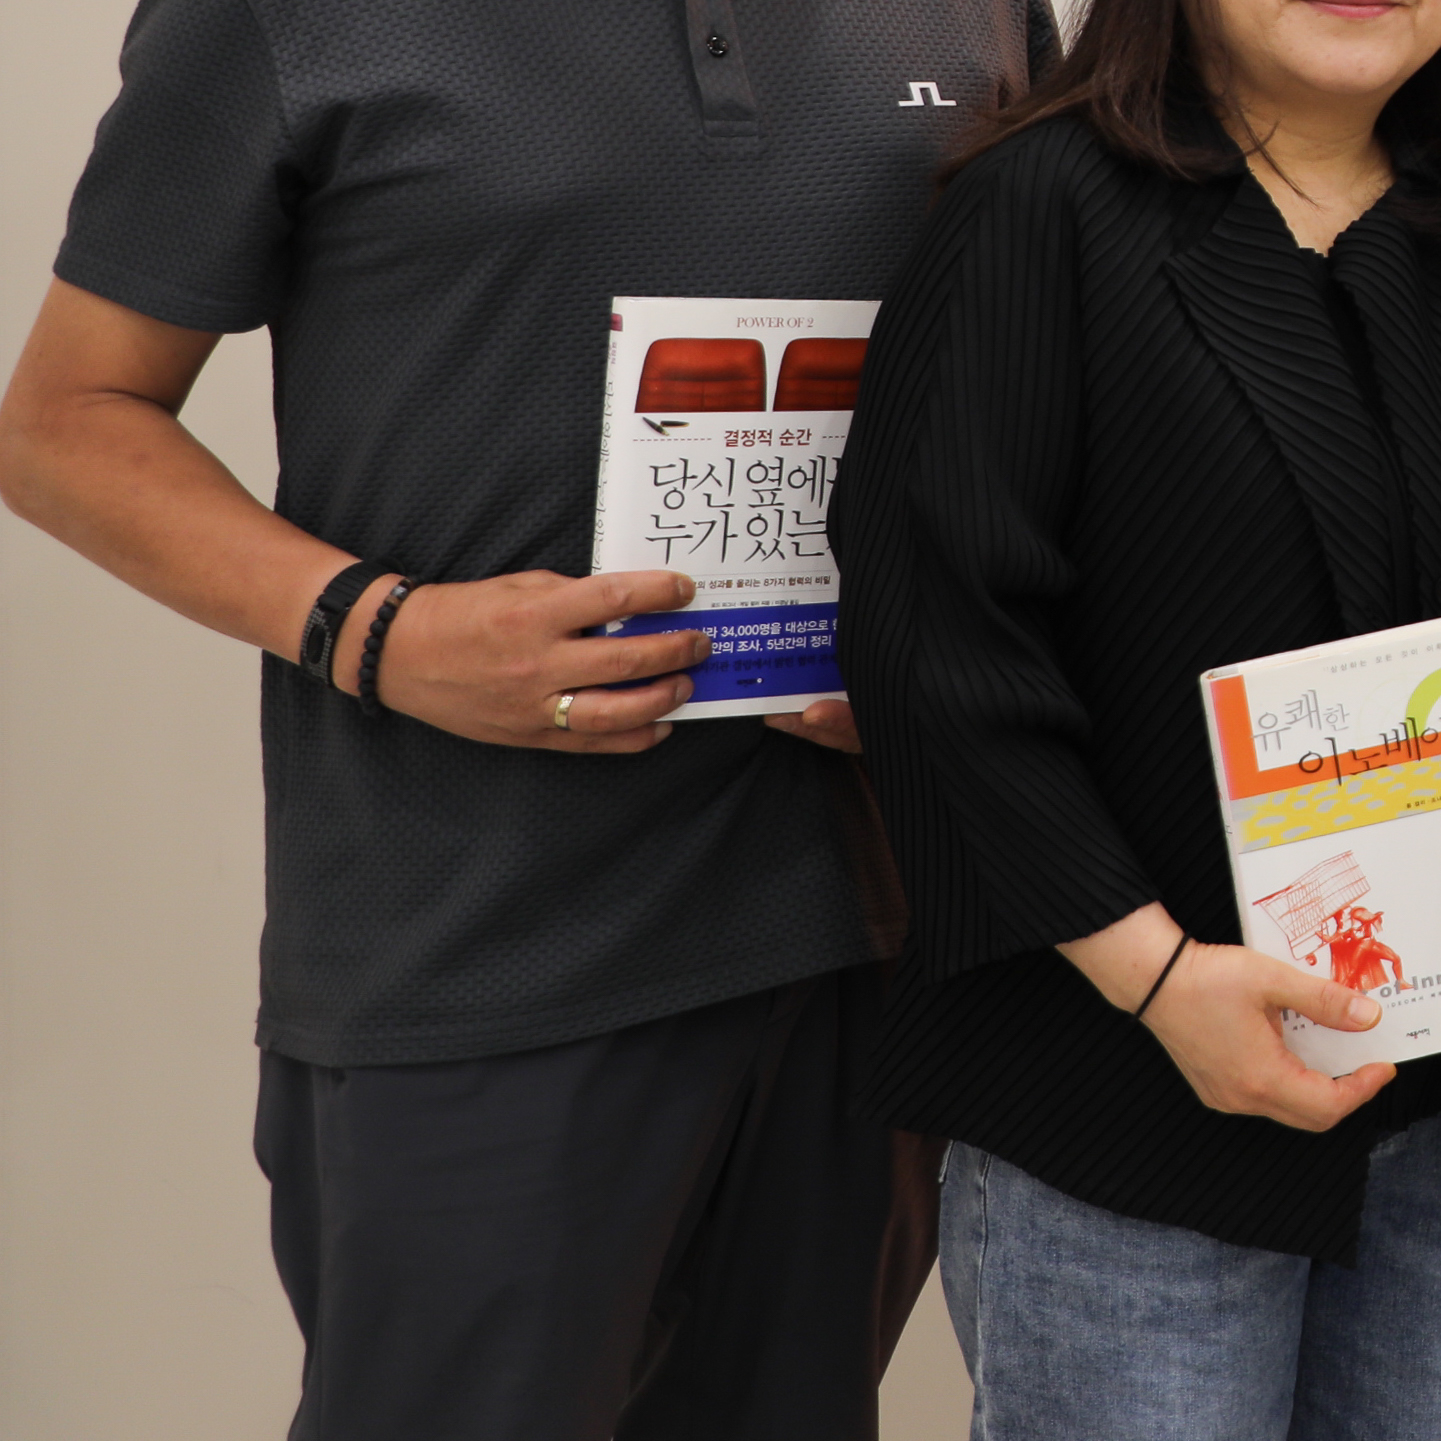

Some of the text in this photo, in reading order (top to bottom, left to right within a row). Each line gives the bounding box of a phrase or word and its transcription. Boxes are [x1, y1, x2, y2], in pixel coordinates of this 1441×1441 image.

[736, 317, 815, 328] POWER OF 2
[723, 428, 813, 447] 결정적 순간
[649, 454, 841, 510] 당신 옆에
[644, 508, 831, 565] 누가 있는
[708, 578, 735, 590] 성과를
[736, 577, 761, 589] 올리는
[763, 576, 786, 588] 8가지
[815, 574, 831, 586] 비밀
[720, 622, 782, 638] 34,000명을
[785, 619, 829, 634] 대상으로
[736, 639, 763, 653] 조사,
[766, 636, 807, 651] 5년간의
[809, 634, 832, 648] 정리
[1253, 689, 1350, 753] 유쾌한
